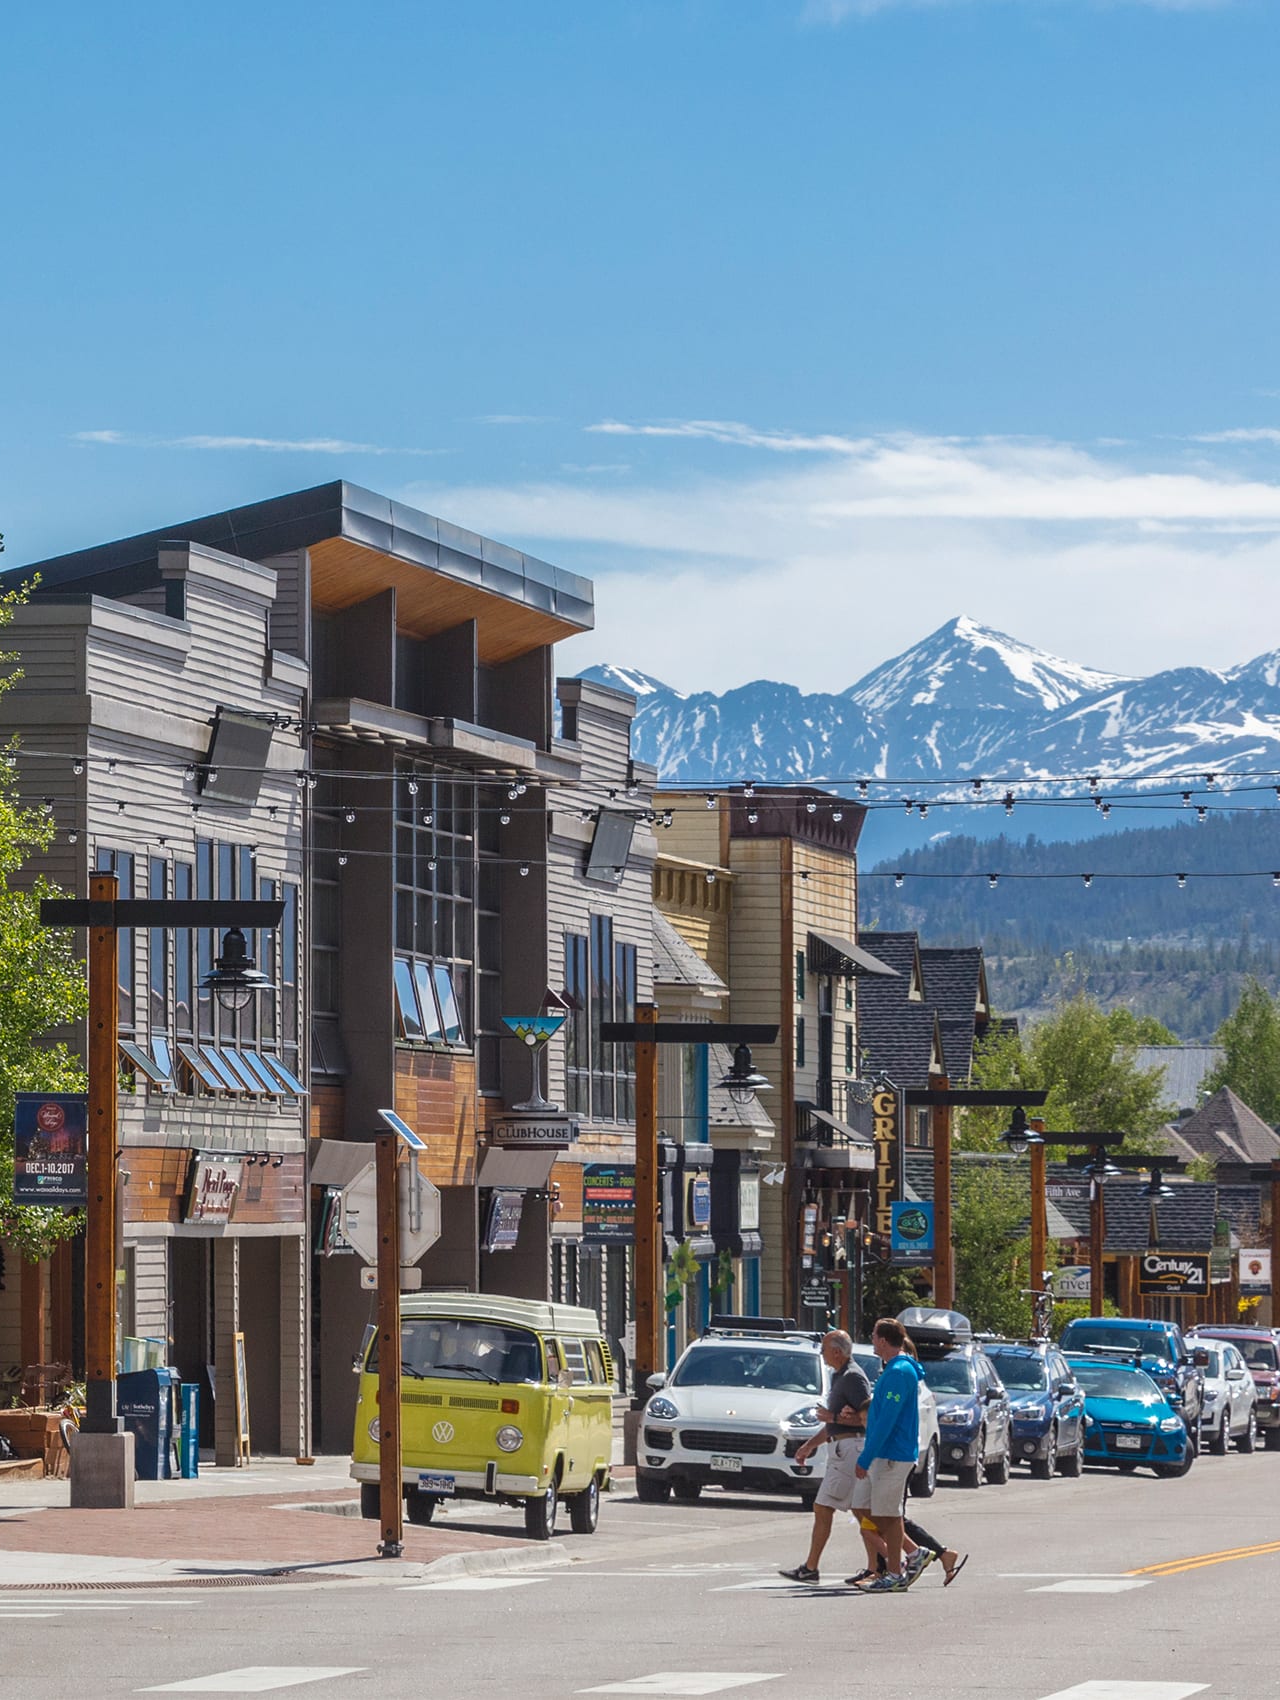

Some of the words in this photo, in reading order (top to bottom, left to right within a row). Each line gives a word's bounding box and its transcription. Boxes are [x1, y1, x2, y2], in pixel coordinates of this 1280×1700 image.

[25, 1162, 75, 1174] DEC.1-10.2017
[872, 1092, 896, 1234] GRILLE
[1065, 1187, 1081, 1197] Ave
[1144, 1255, 1194, 1274] Century
[1187, 1267, 1204, 1285] 21
